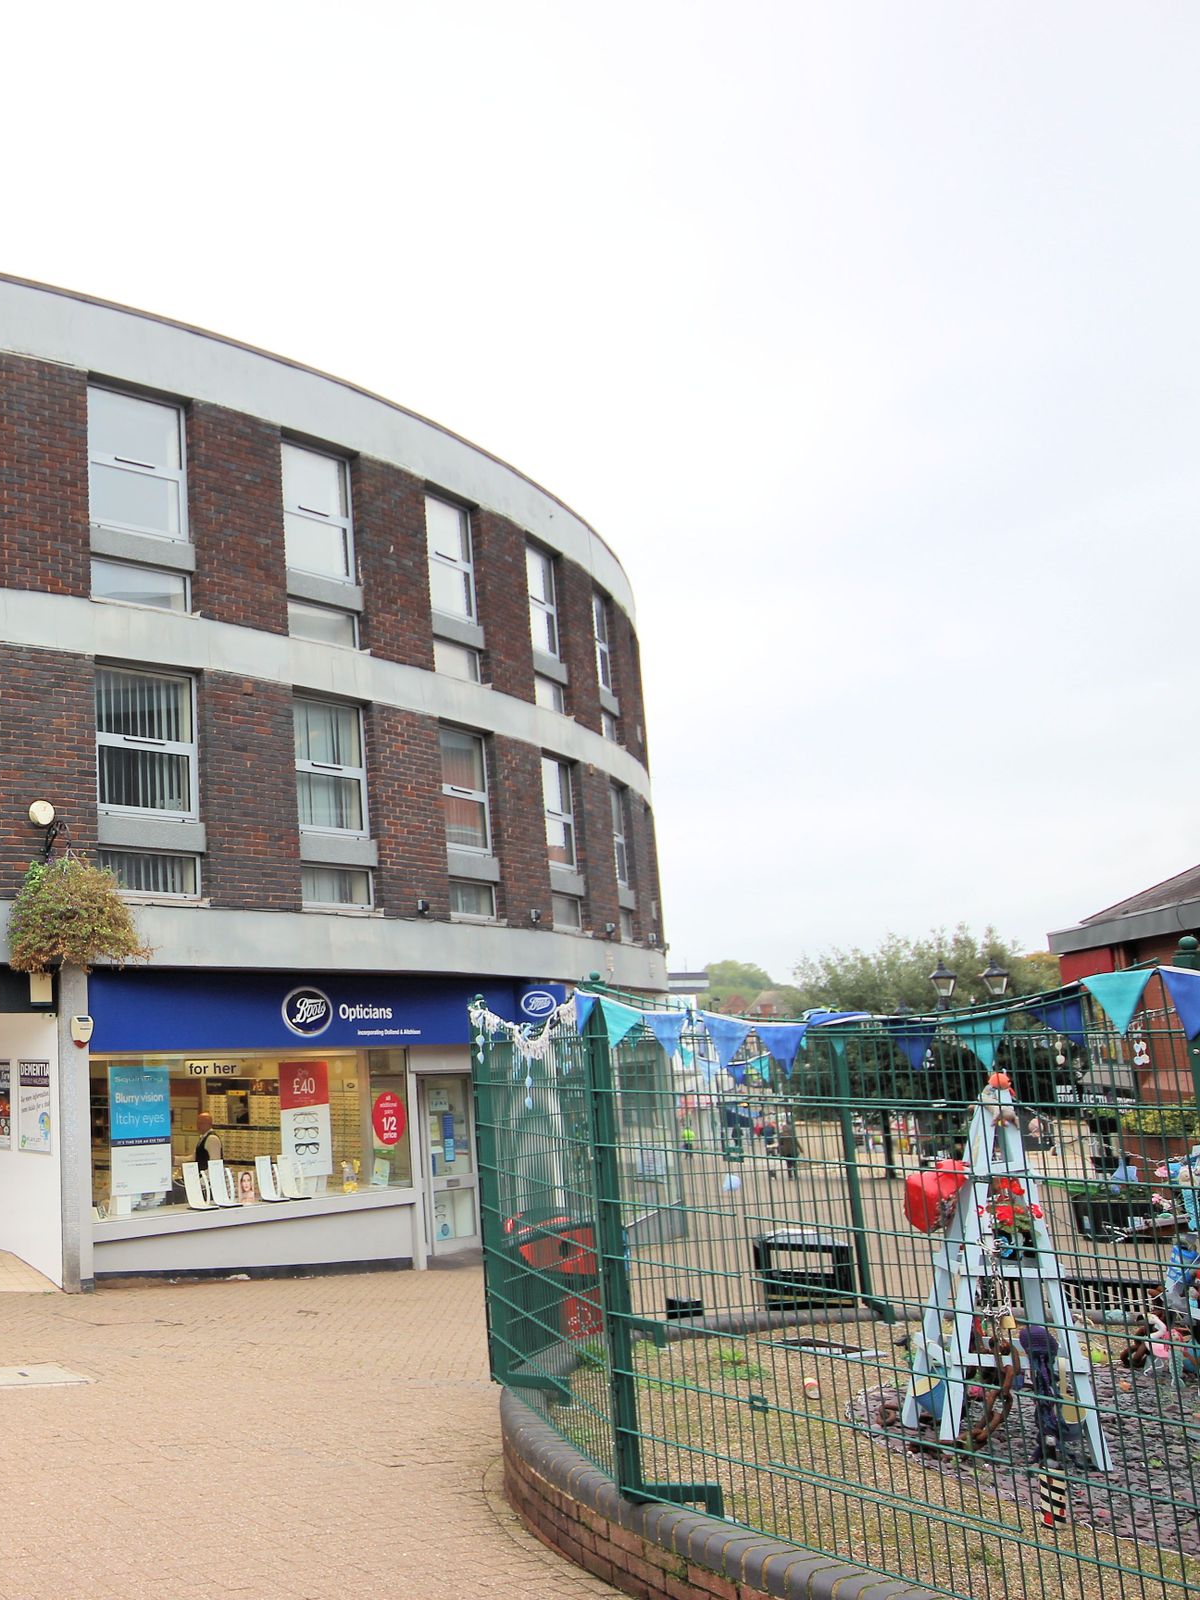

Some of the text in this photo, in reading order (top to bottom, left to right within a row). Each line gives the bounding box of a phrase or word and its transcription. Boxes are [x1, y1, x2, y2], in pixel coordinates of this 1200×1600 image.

[292, 997, 326, 1023] Boots
[527, 996, 551, 1011] Boots
[339, 1004, 392, 1022] Opticians
[20, 1063, 49, 1076] DEMENTIA
[189, 1062, 237, 1075] for her
[292, 1078, 316, 1094] £40
[115, 1092, 164, 1106] Blurry vision
[116, 1112, 165, 1126] Itchy eyes
[382, 1116, 397, 1131] 1/2
[383, 1132, 398, 1140] price
